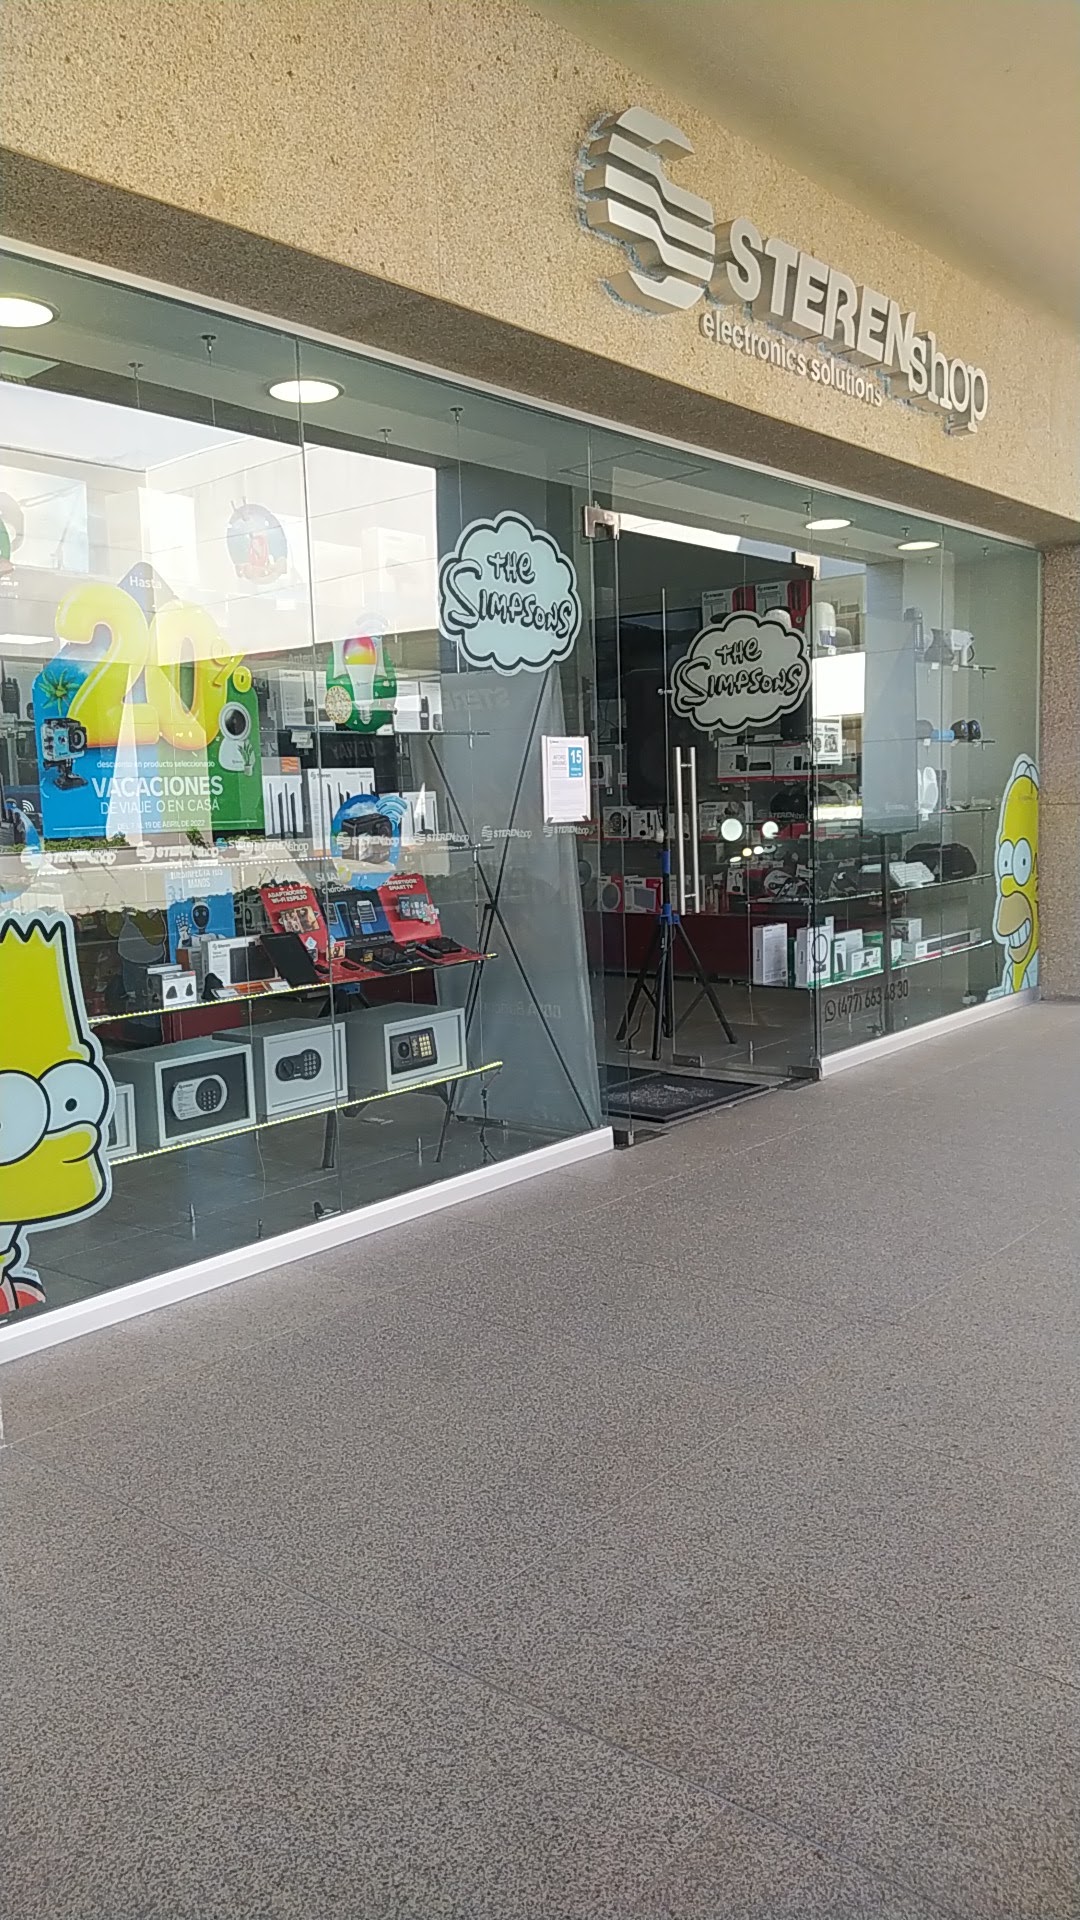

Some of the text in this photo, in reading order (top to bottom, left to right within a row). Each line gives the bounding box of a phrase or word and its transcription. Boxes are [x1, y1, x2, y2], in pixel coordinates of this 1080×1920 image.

[725, 216, 989, 433] STERENshop
[701, 310, 884, 407] electronics solutions
[129, 575, 163, 589] Hasta
[55, 581, 252, 751] 20%
[143, 761, 173, 770] producto
[174, 759, 215, 768] seleccionado
[570, 749, 582, 764] 15
[92, 776, 223, 798] VACACIONES
[100, 798, 220, 815] DE VIAJE O EN CASA
[268, 888, 308, 899] ADAPTADORES
[838, 993, 862, 1018] (477)
[864, 987, 882, 1008] 663
[896, 979, 909, 999] 30
